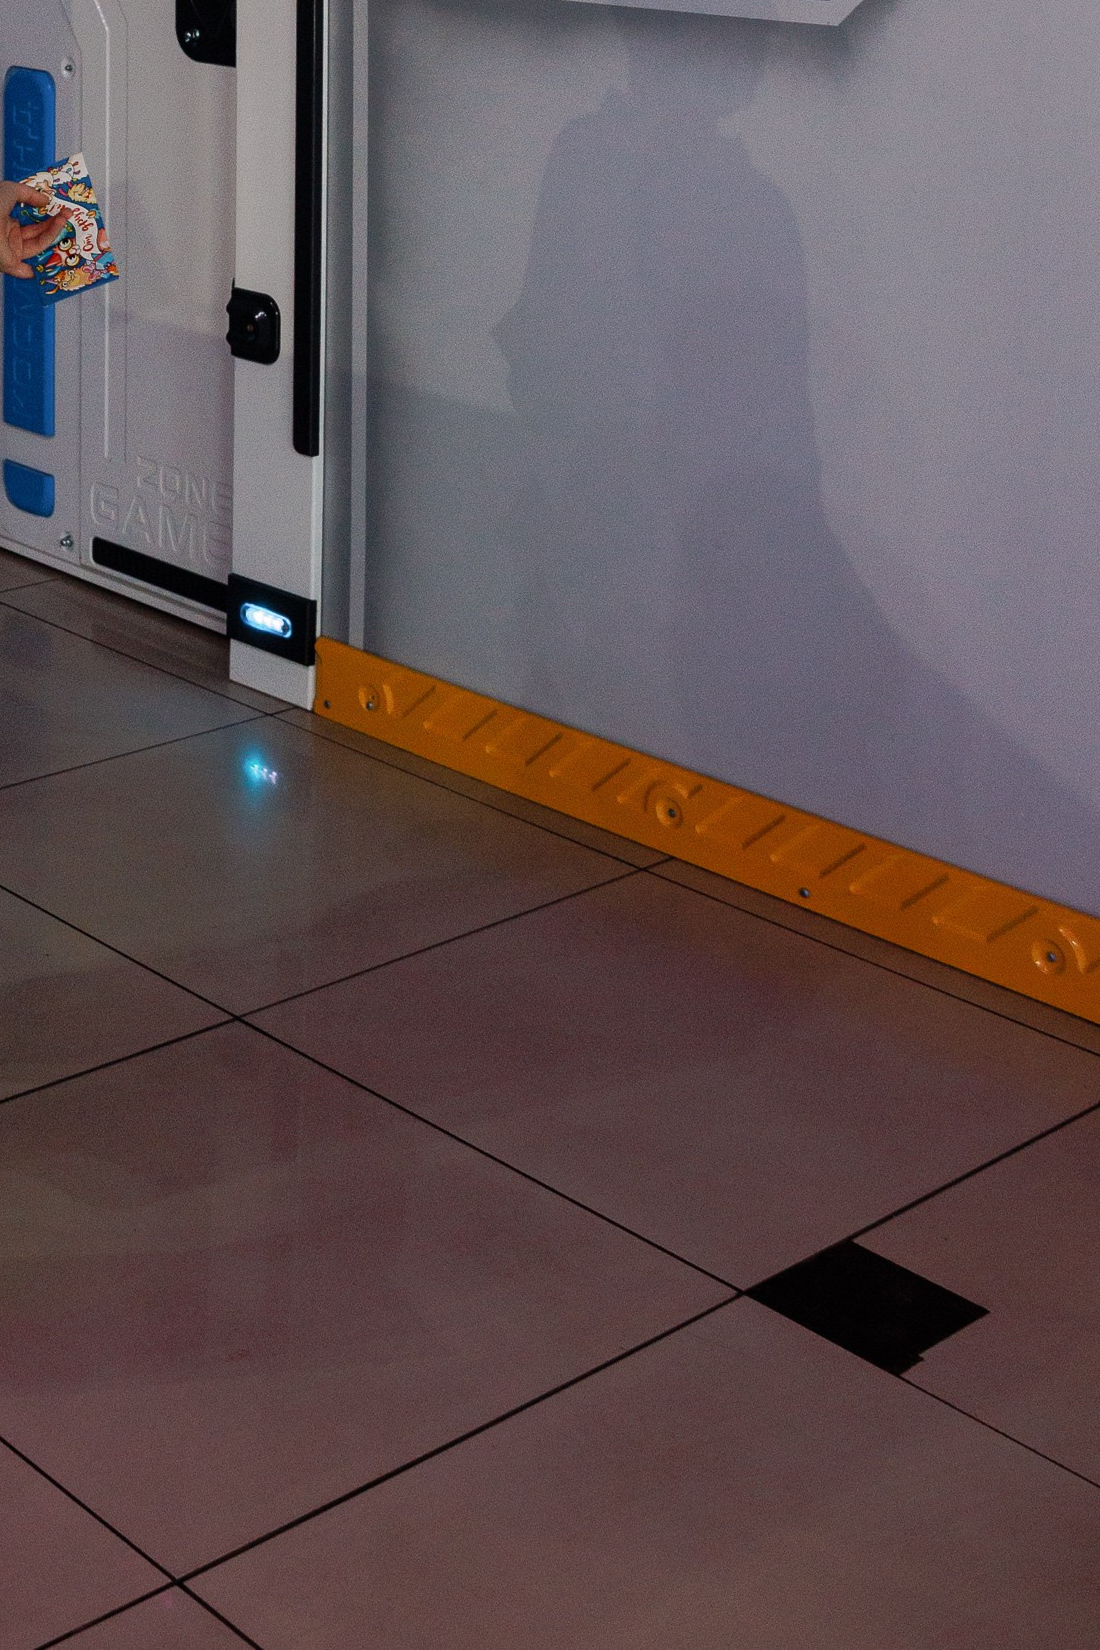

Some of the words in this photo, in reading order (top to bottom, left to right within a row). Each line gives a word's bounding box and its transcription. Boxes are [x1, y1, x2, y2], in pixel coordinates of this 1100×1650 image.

[83, 233, 95, 252] От
[135, 455, 233, 515] ZONE
[90, 481, 233, 567] GAME
